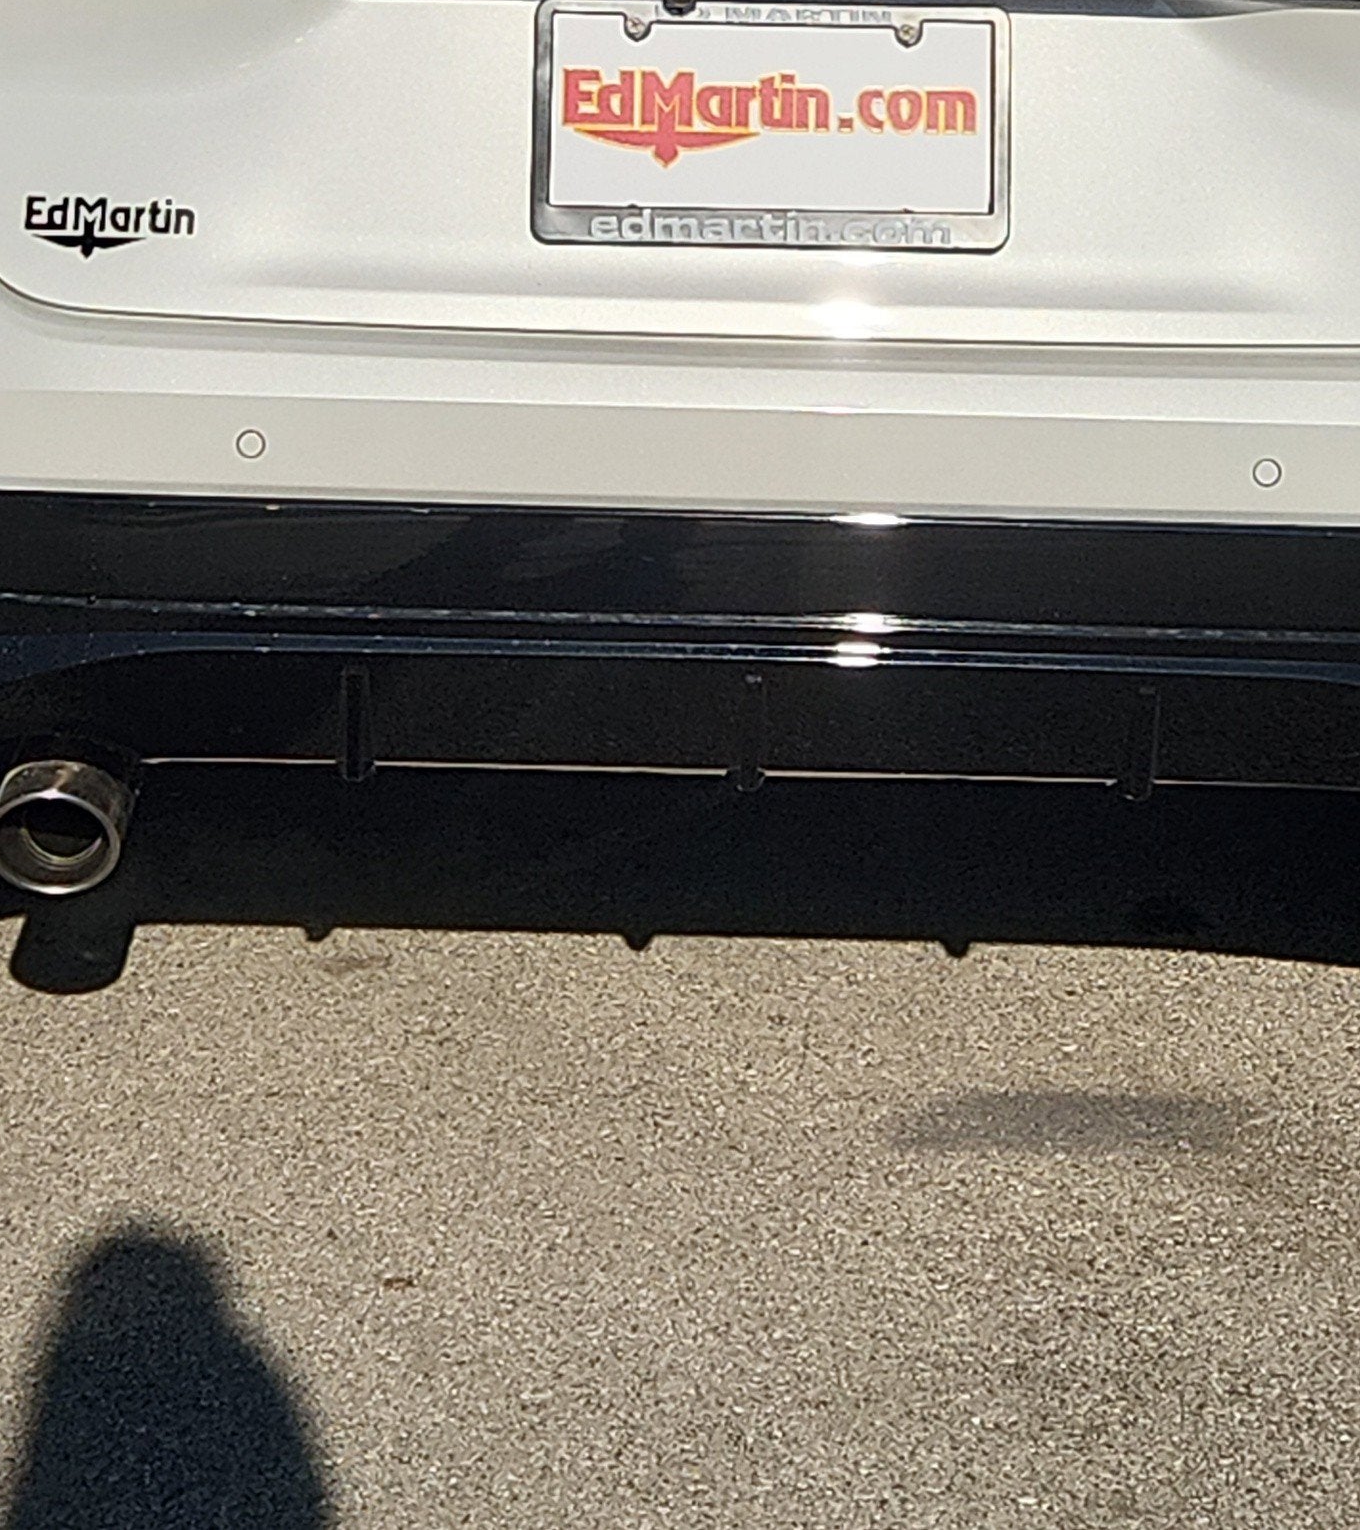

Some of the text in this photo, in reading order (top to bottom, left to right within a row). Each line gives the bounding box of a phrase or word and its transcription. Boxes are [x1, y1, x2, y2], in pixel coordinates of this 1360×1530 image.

[725, 7, 892, 23] MARTIN
[562, 68, 978, 136] EdMartin.com
[24, 195, 196, 236] EdMartin
[590, 209, 953, 245] edmartin.com
